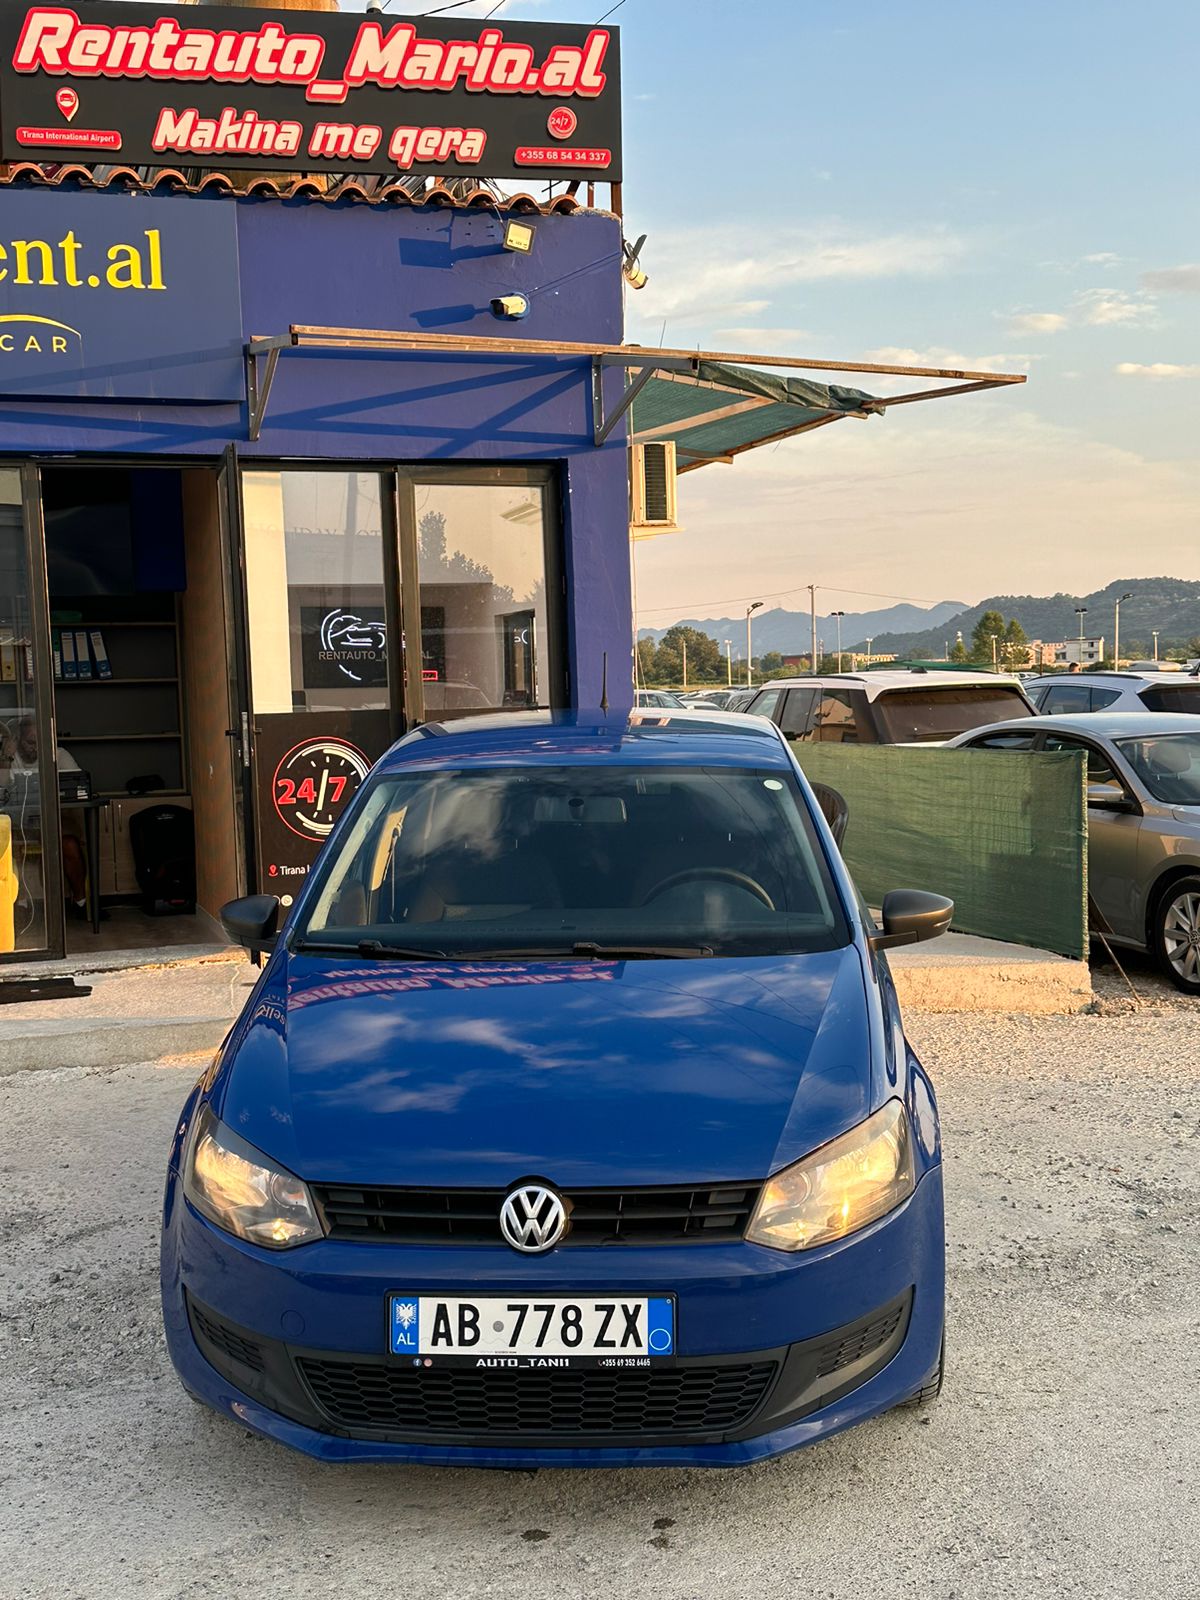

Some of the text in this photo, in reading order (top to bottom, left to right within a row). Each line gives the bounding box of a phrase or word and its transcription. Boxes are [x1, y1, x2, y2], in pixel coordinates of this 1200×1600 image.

[13, 8, 609, 103] Rentauto_Mario.al
[551, 116, 568, 128] 24/7
[22, 131, 115, 143] Tirana International Airport
[152, 108, 302, 156] Makina
[308, 122, 382, 158] me
[521, 151, 606, 161] +355 68 54 34 337
[0, 230, 167, 289] nt.al
[0, 334, 67, 353] CAR
[280, 866, 306, 876] Tirana
[431, 1303, 643, 1348] AB 778 ZX
[397, 1333, 415, 1346] AL
[617, 1358, 624, 1367] 69
[625, 1358, 636, 1367] 352
[637, 1358, 651, 1367] 6465
